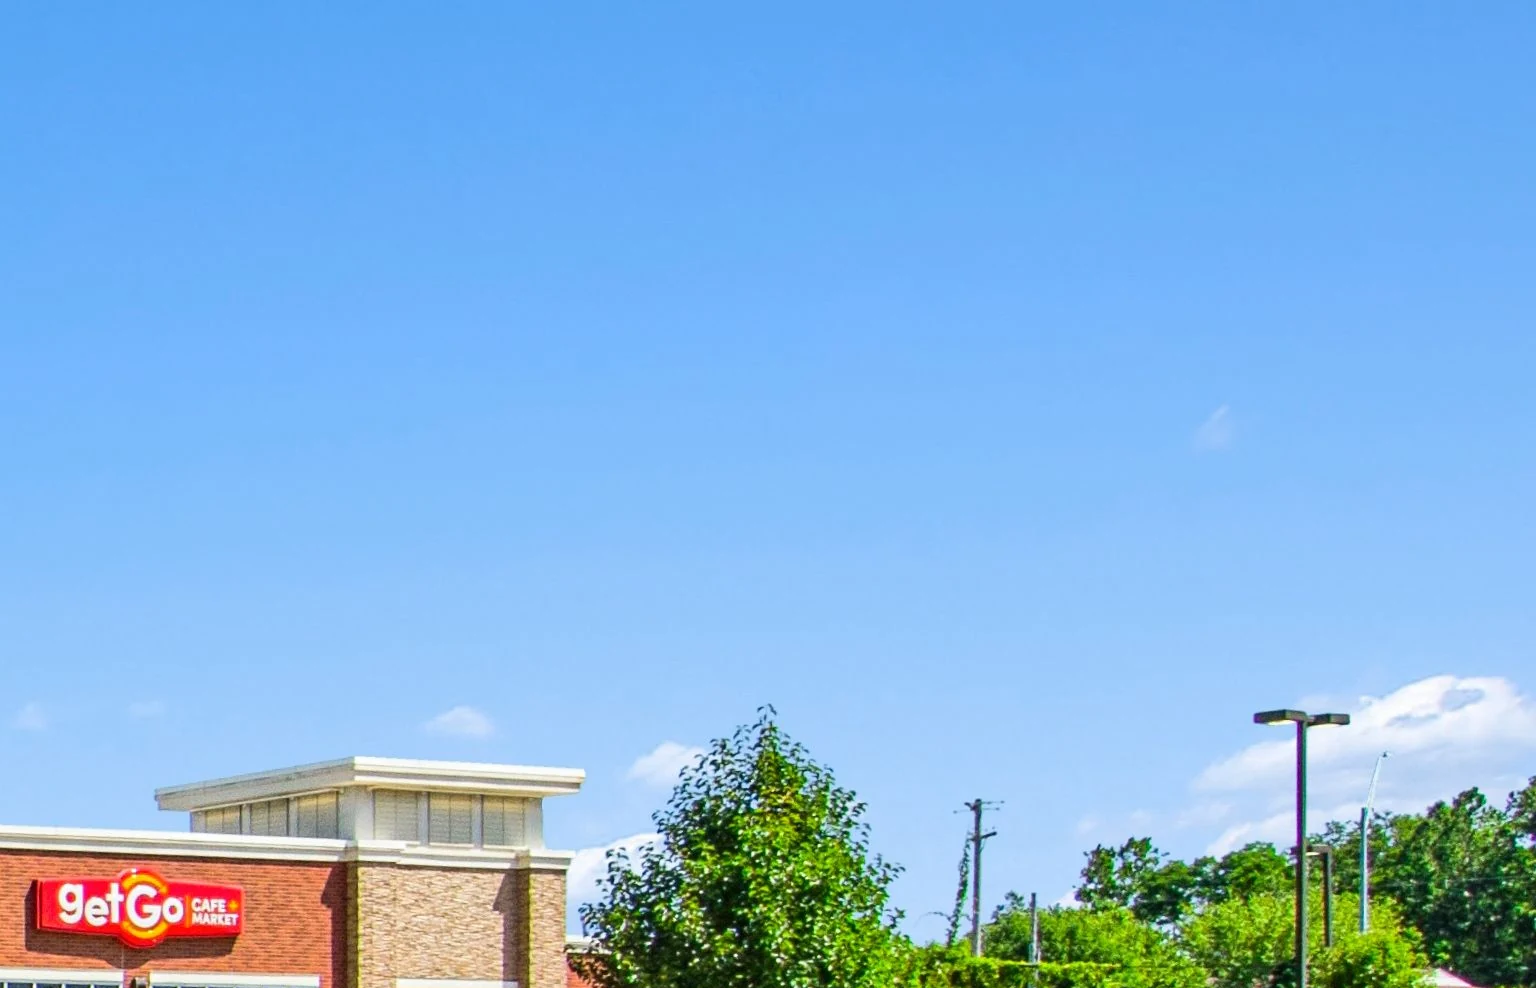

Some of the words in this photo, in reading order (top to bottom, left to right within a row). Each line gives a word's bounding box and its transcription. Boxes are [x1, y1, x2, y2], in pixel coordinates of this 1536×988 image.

[58, 882, 184, 928] getGo
[191, 898, 226, 912] CAFE
[191, 914, 239, 926] MARKET
